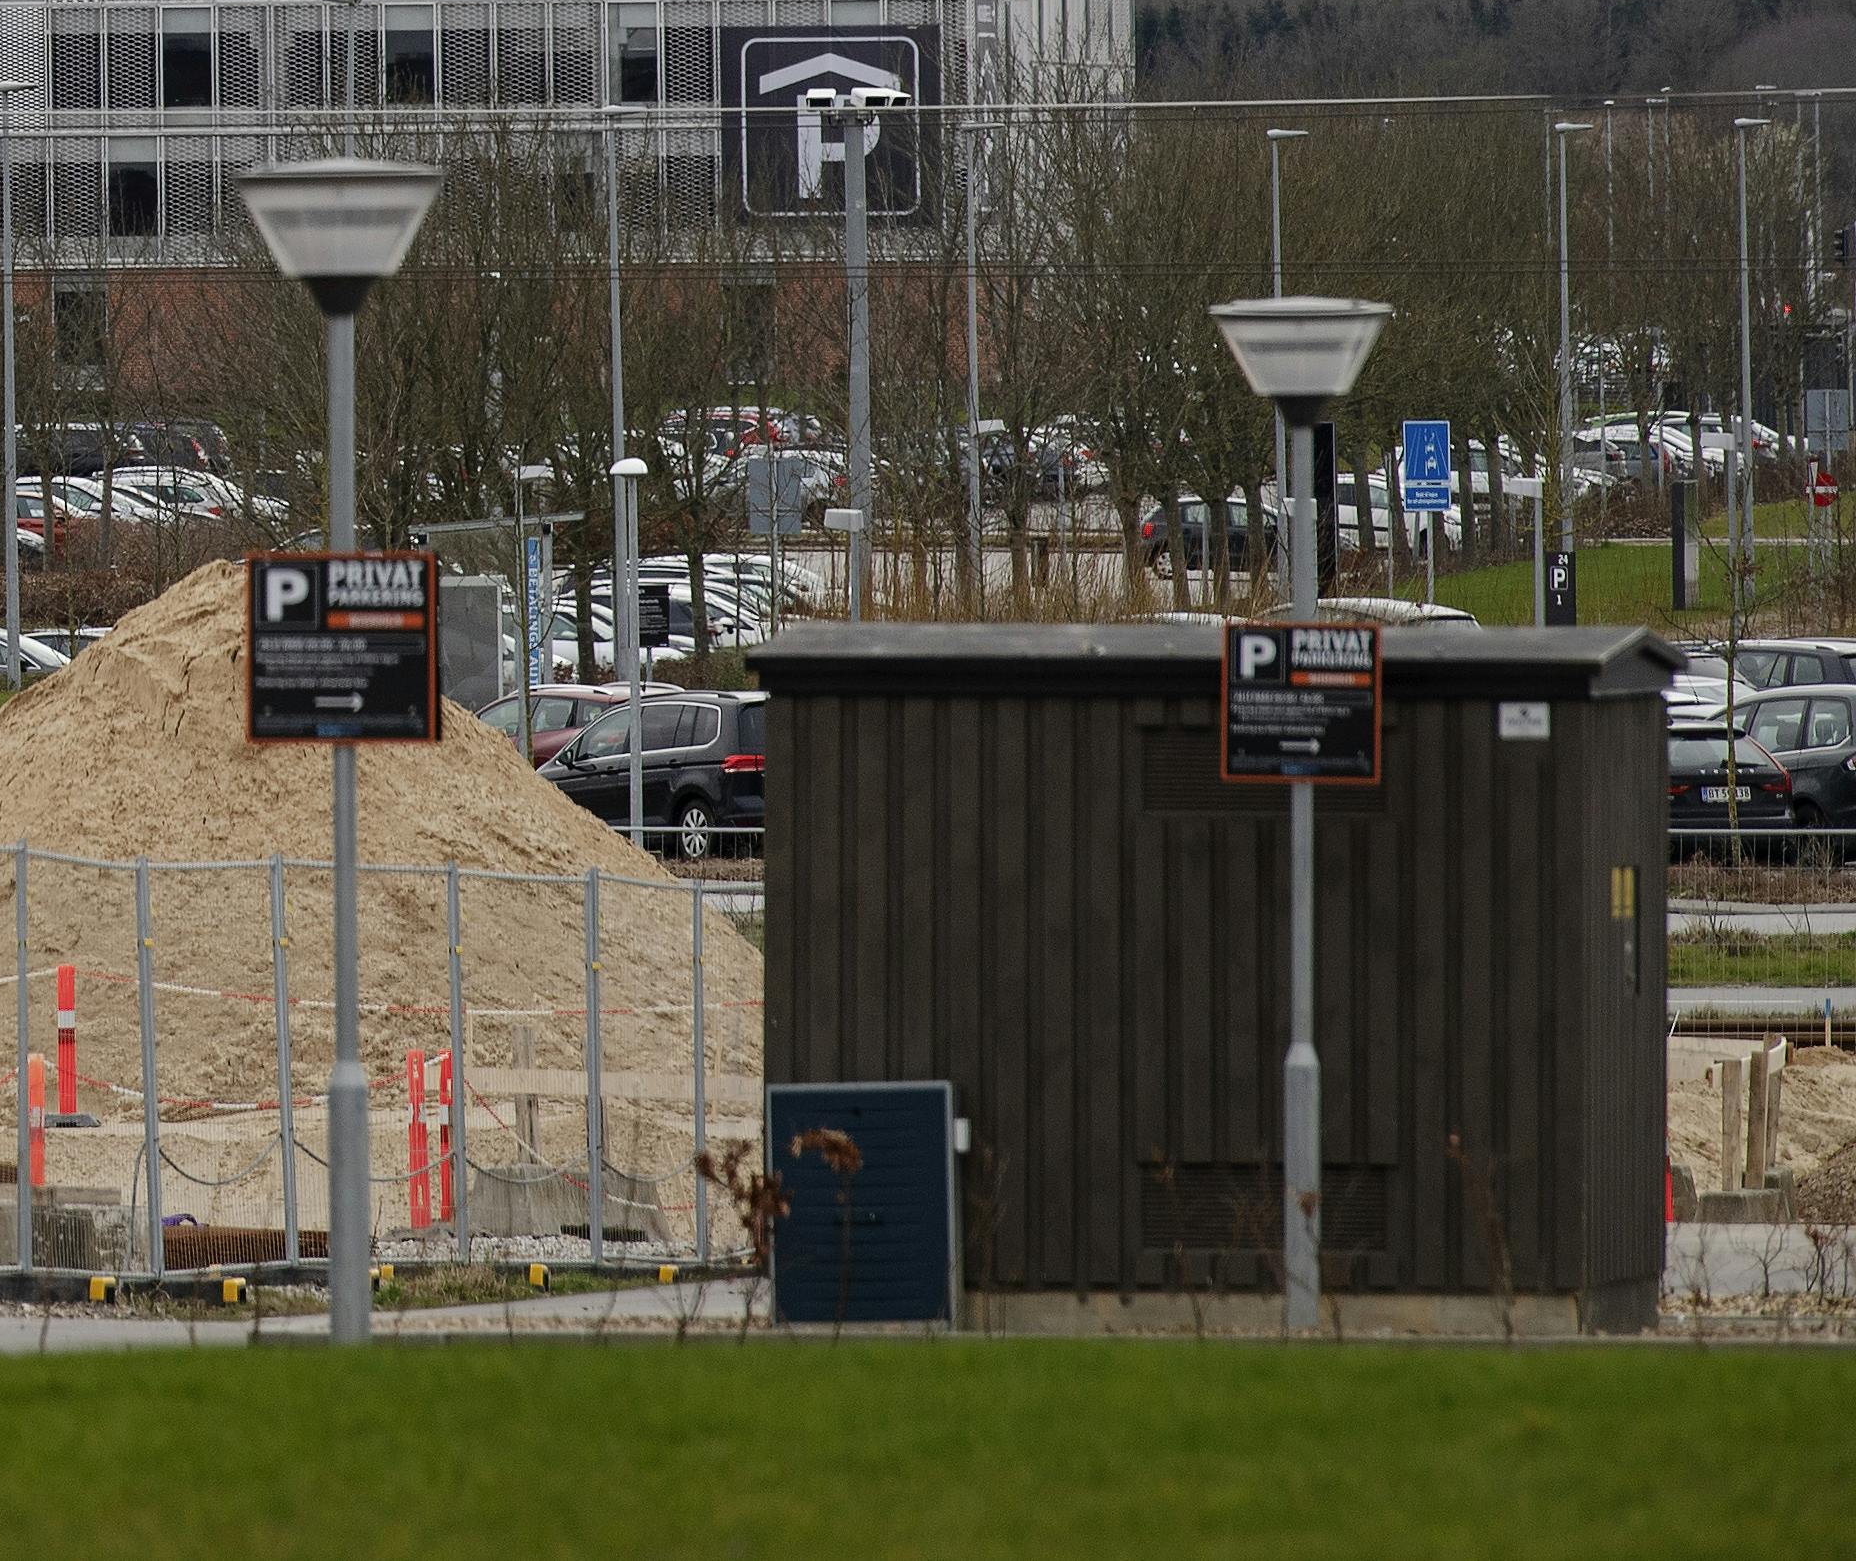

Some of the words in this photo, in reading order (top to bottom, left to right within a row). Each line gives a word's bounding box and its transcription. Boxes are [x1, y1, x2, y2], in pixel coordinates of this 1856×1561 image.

[1558, 554, 1568, 565] 24
[328, 560, 426, 590] PRIVAT
[1554, 568, 1566, 588] P
[267, 568, 310, 623] P
[1291, 629, 1373, 650] PRIVAT
[1240, 634, 1277, 679] P
